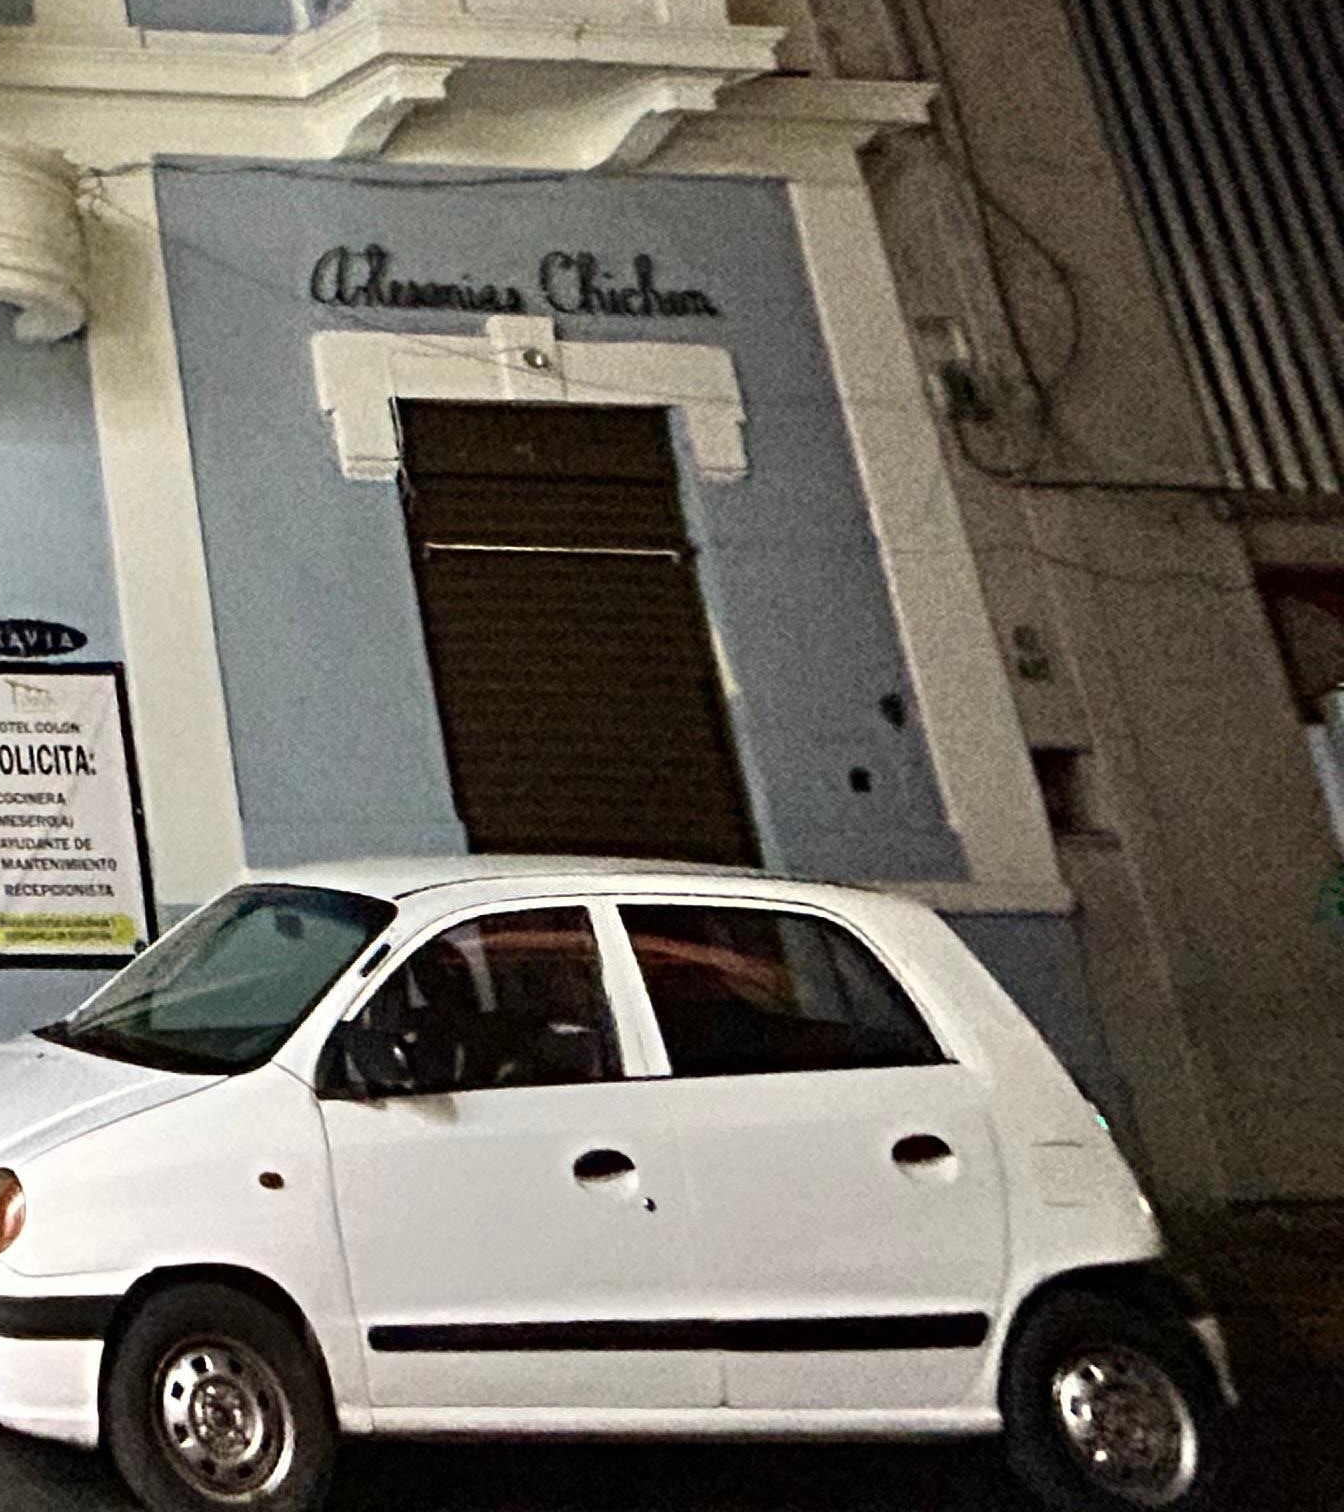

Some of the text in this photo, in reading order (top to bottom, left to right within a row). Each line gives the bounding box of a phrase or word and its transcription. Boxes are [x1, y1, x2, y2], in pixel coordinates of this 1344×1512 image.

[34, 721, 81, 734] COLON
[73, 837, 94, 851] DE
[0, 857, 118, 872] MANTENIMIENTO
[3, 883, 116, 897] RECEPCIONISTA
